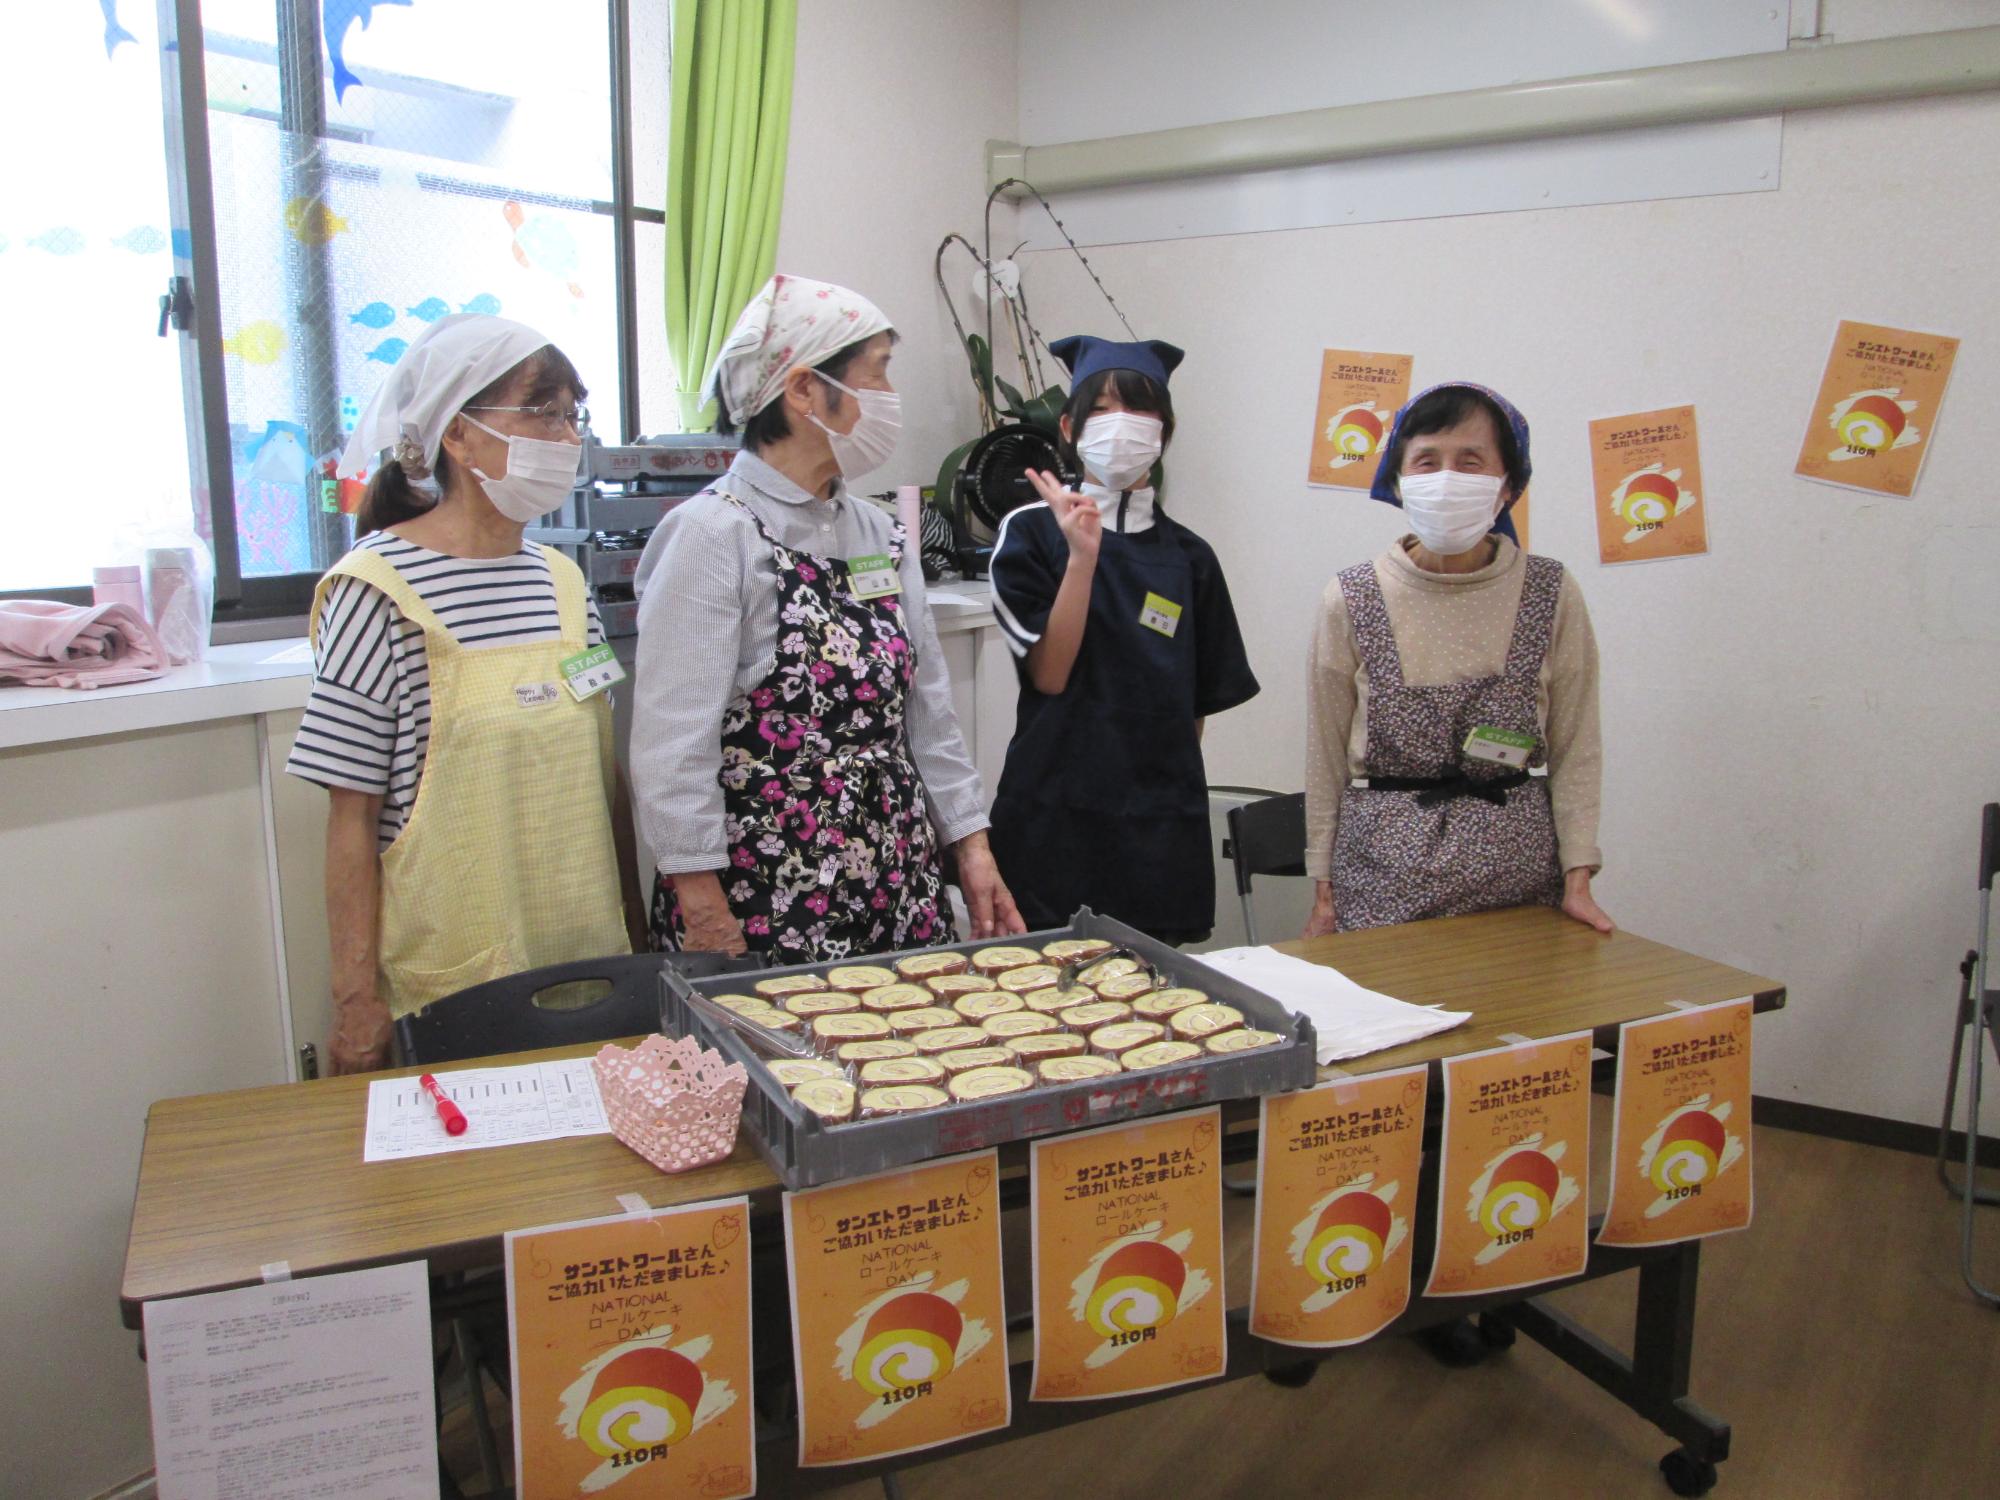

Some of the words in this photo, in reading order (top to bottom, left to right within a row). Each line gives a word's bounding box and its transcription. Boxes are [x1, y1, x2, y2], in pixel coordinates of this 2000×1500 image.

[566, 650, 609, 673] STAFF
[1479, 1067, 1572, 1097] サンエトワールさん
[1301, 1103, 1403, 1135] サンエトワールさん
[1494, 1106, 1544, 1124] NATIONAL
[1077, 1147, 1195, 1182] サンエトワールさん
[1319, 1143, 1374, 1163] NATIONAL
[1316, 1155, 1382, 1177] ロールケーキ
[1336, 1172, 1361, 1186] DAY
[1098, 1189, 1161, 1212] NATIONAL
[1666, 1184, 1702, 1201] 110円
[837, 1193, 970, 1233] サンエトワールさん
[1096, 1202, 1170, 1226] ロールケーキ
[1119, 1220, 1148, 1236] DAY
[1496, 1227, 1534, 1247] 110円
[564, 1244, 716, 1281] サンエトワールさん
[862, 1239, 933, 1264] NATIONAL
[860, 1250, 943, 1279] ロールケーキ
[886, 1271, 917, 1288] DAY
[1326, 1273, 1367, 1294] 110円
[591, 1291, 672, 1314] NATIONAL
[589, 1305, 683, 1330] ロールケーキ
[618, 1324, 653, 1341] DAY
[1111, 1326, 1156, 1348] 110円
[882, 1381, 933, 1406] 110円
[611, 1443, 668, 1468] 110円
